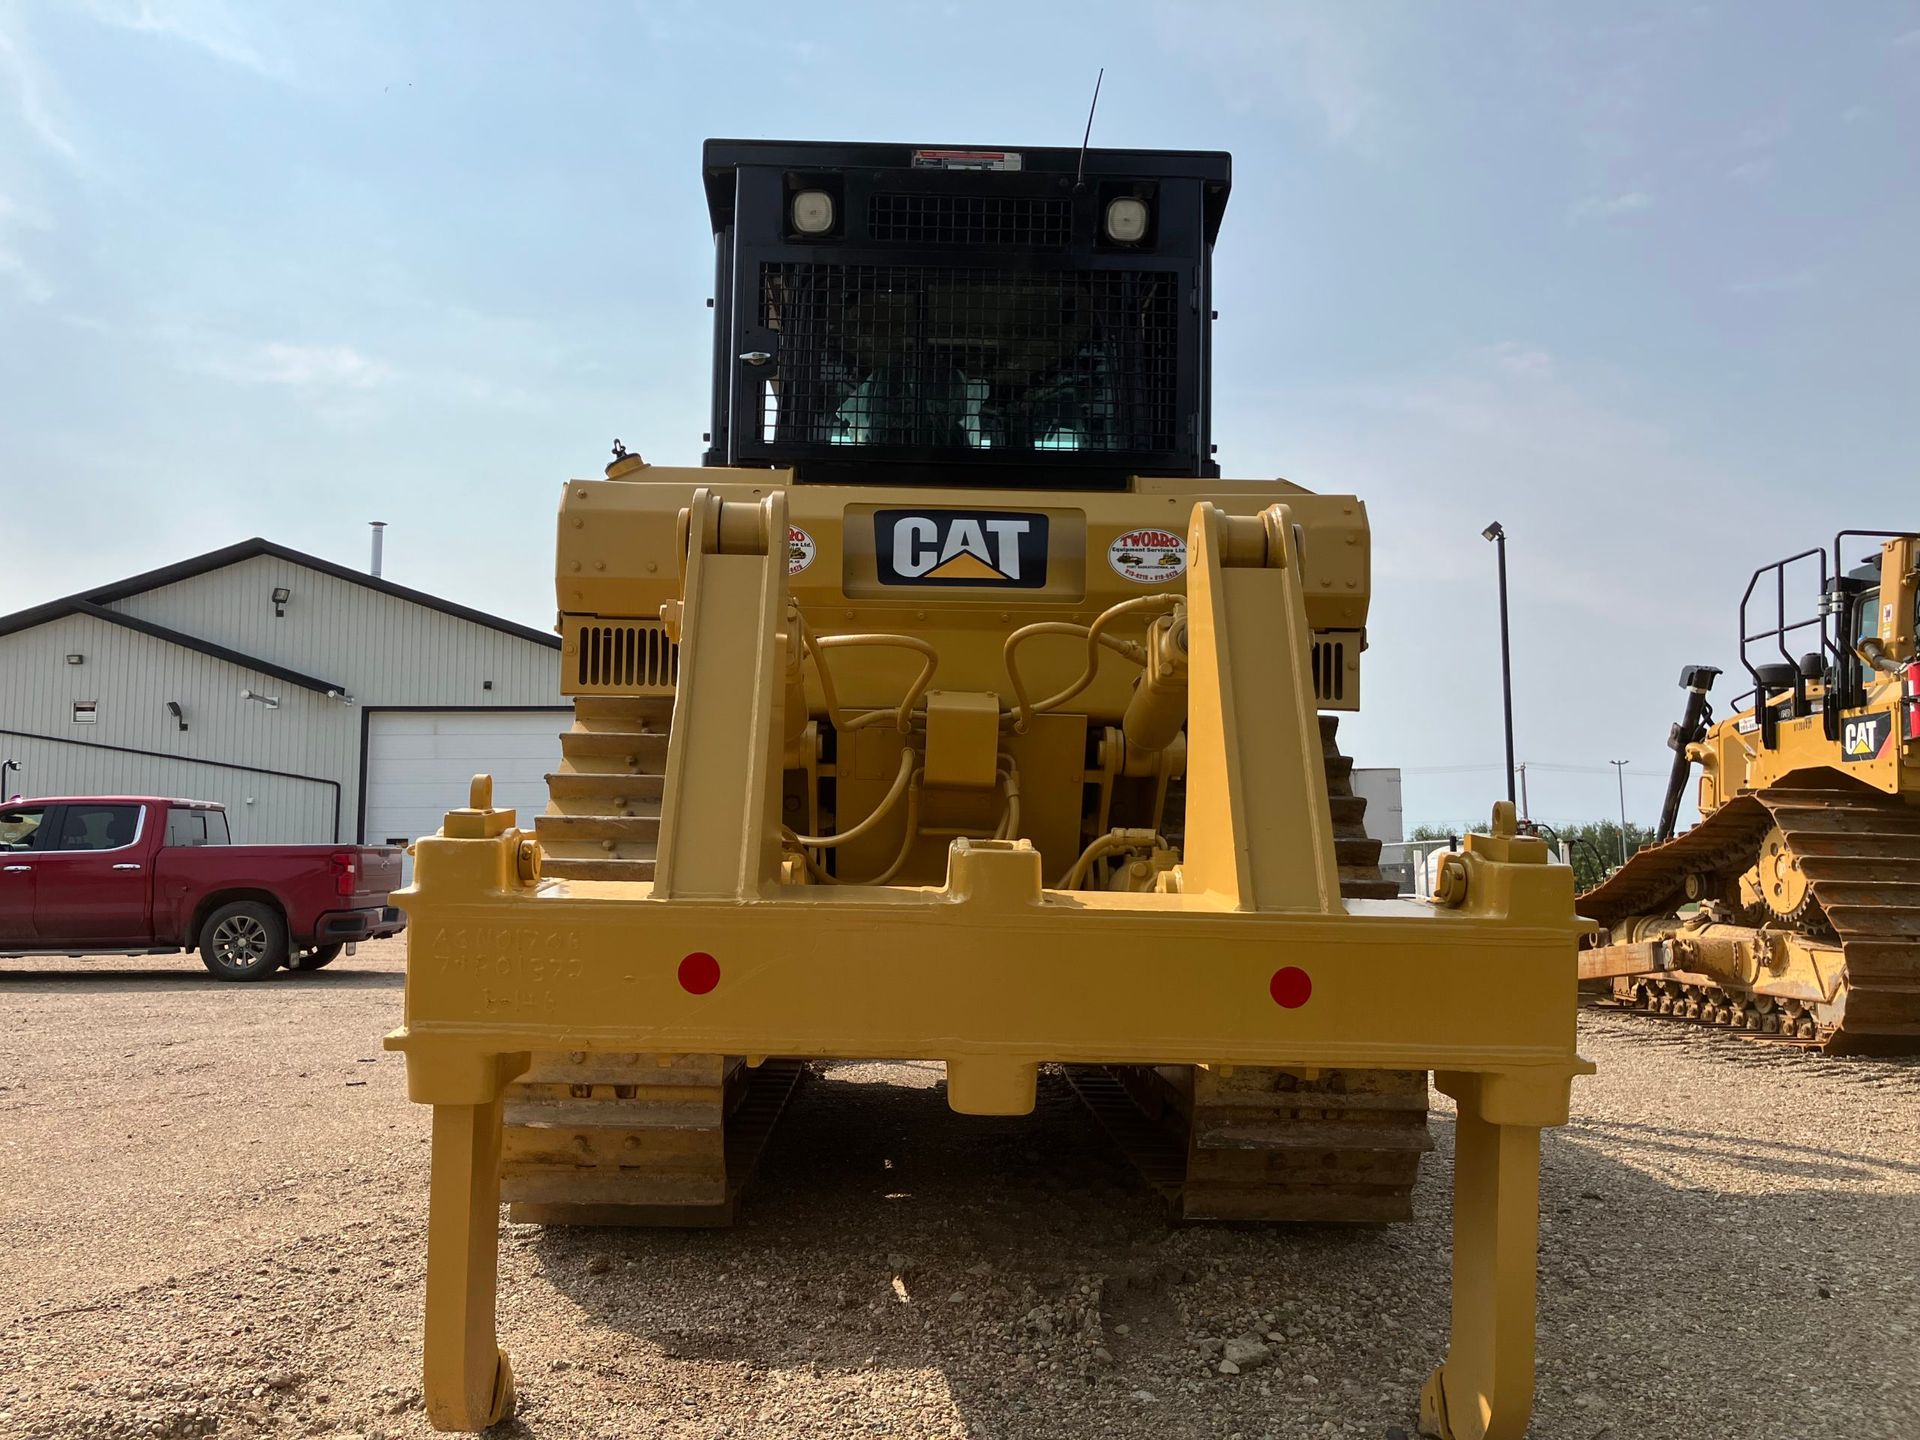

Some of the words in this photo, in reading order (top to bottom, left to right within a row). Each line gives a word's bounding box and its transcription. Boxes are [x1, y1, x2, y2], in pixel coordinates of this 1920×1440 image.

[893, 517, 1030, 580] CAT
[1120, 532, 1180, 548] TWOBRO
[1845, 720, 1877, 755] CAT
